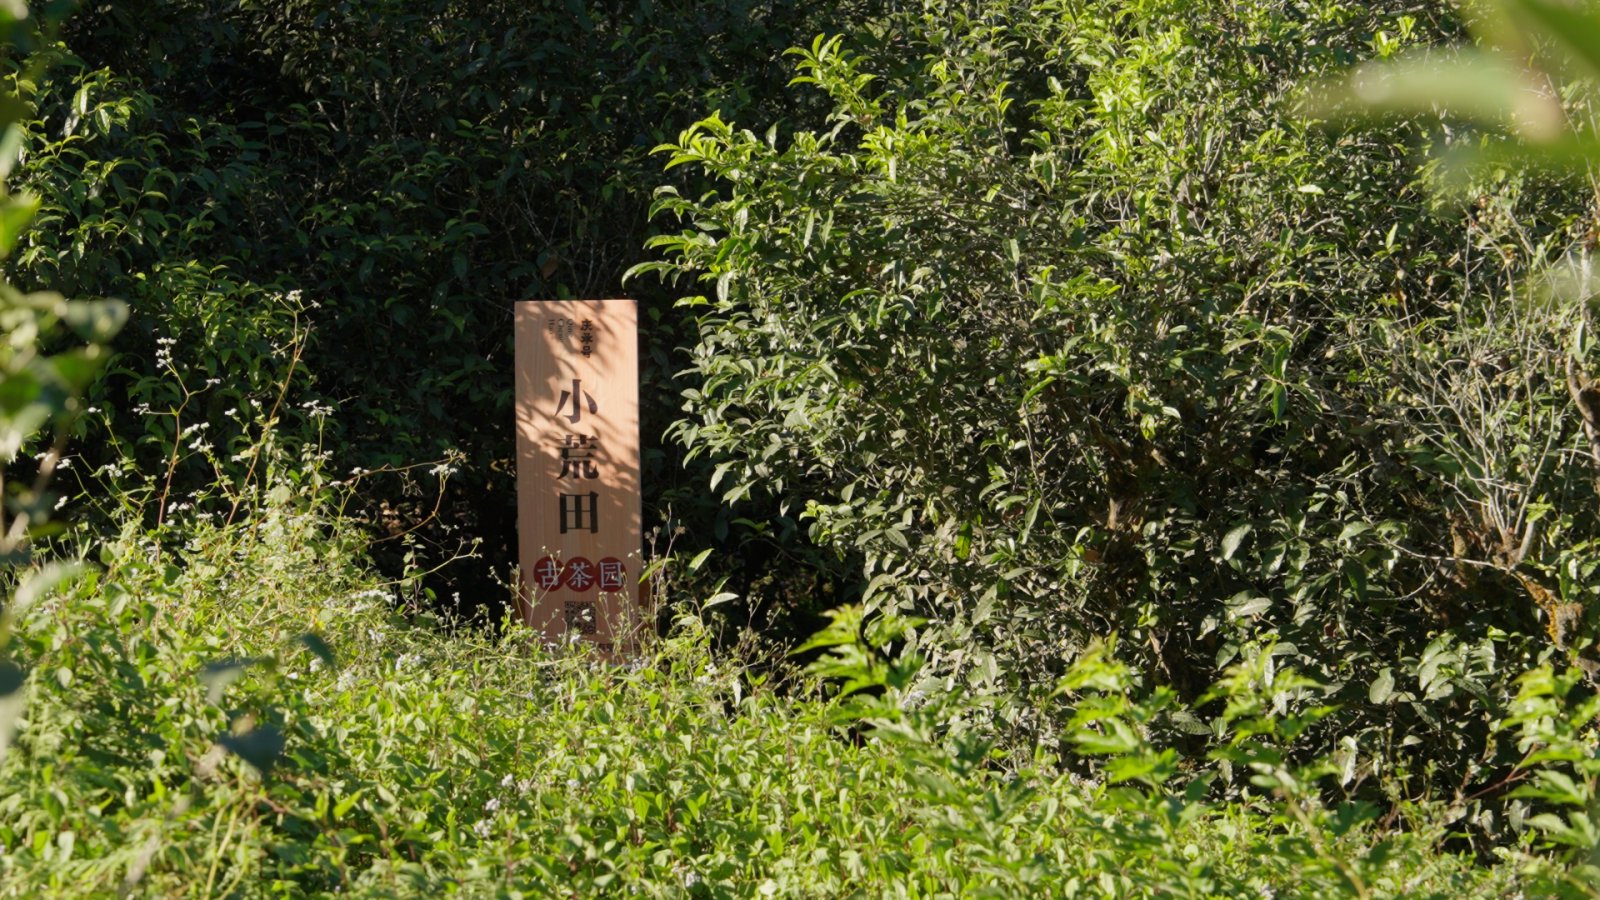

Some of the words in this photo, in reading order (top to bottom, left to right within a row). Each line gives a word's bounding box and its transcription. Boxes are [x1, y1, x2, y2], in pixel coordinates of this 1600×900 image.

[555, 378, 600, 534] 小荒田
[538, 561, 622, 589] 古茶园
